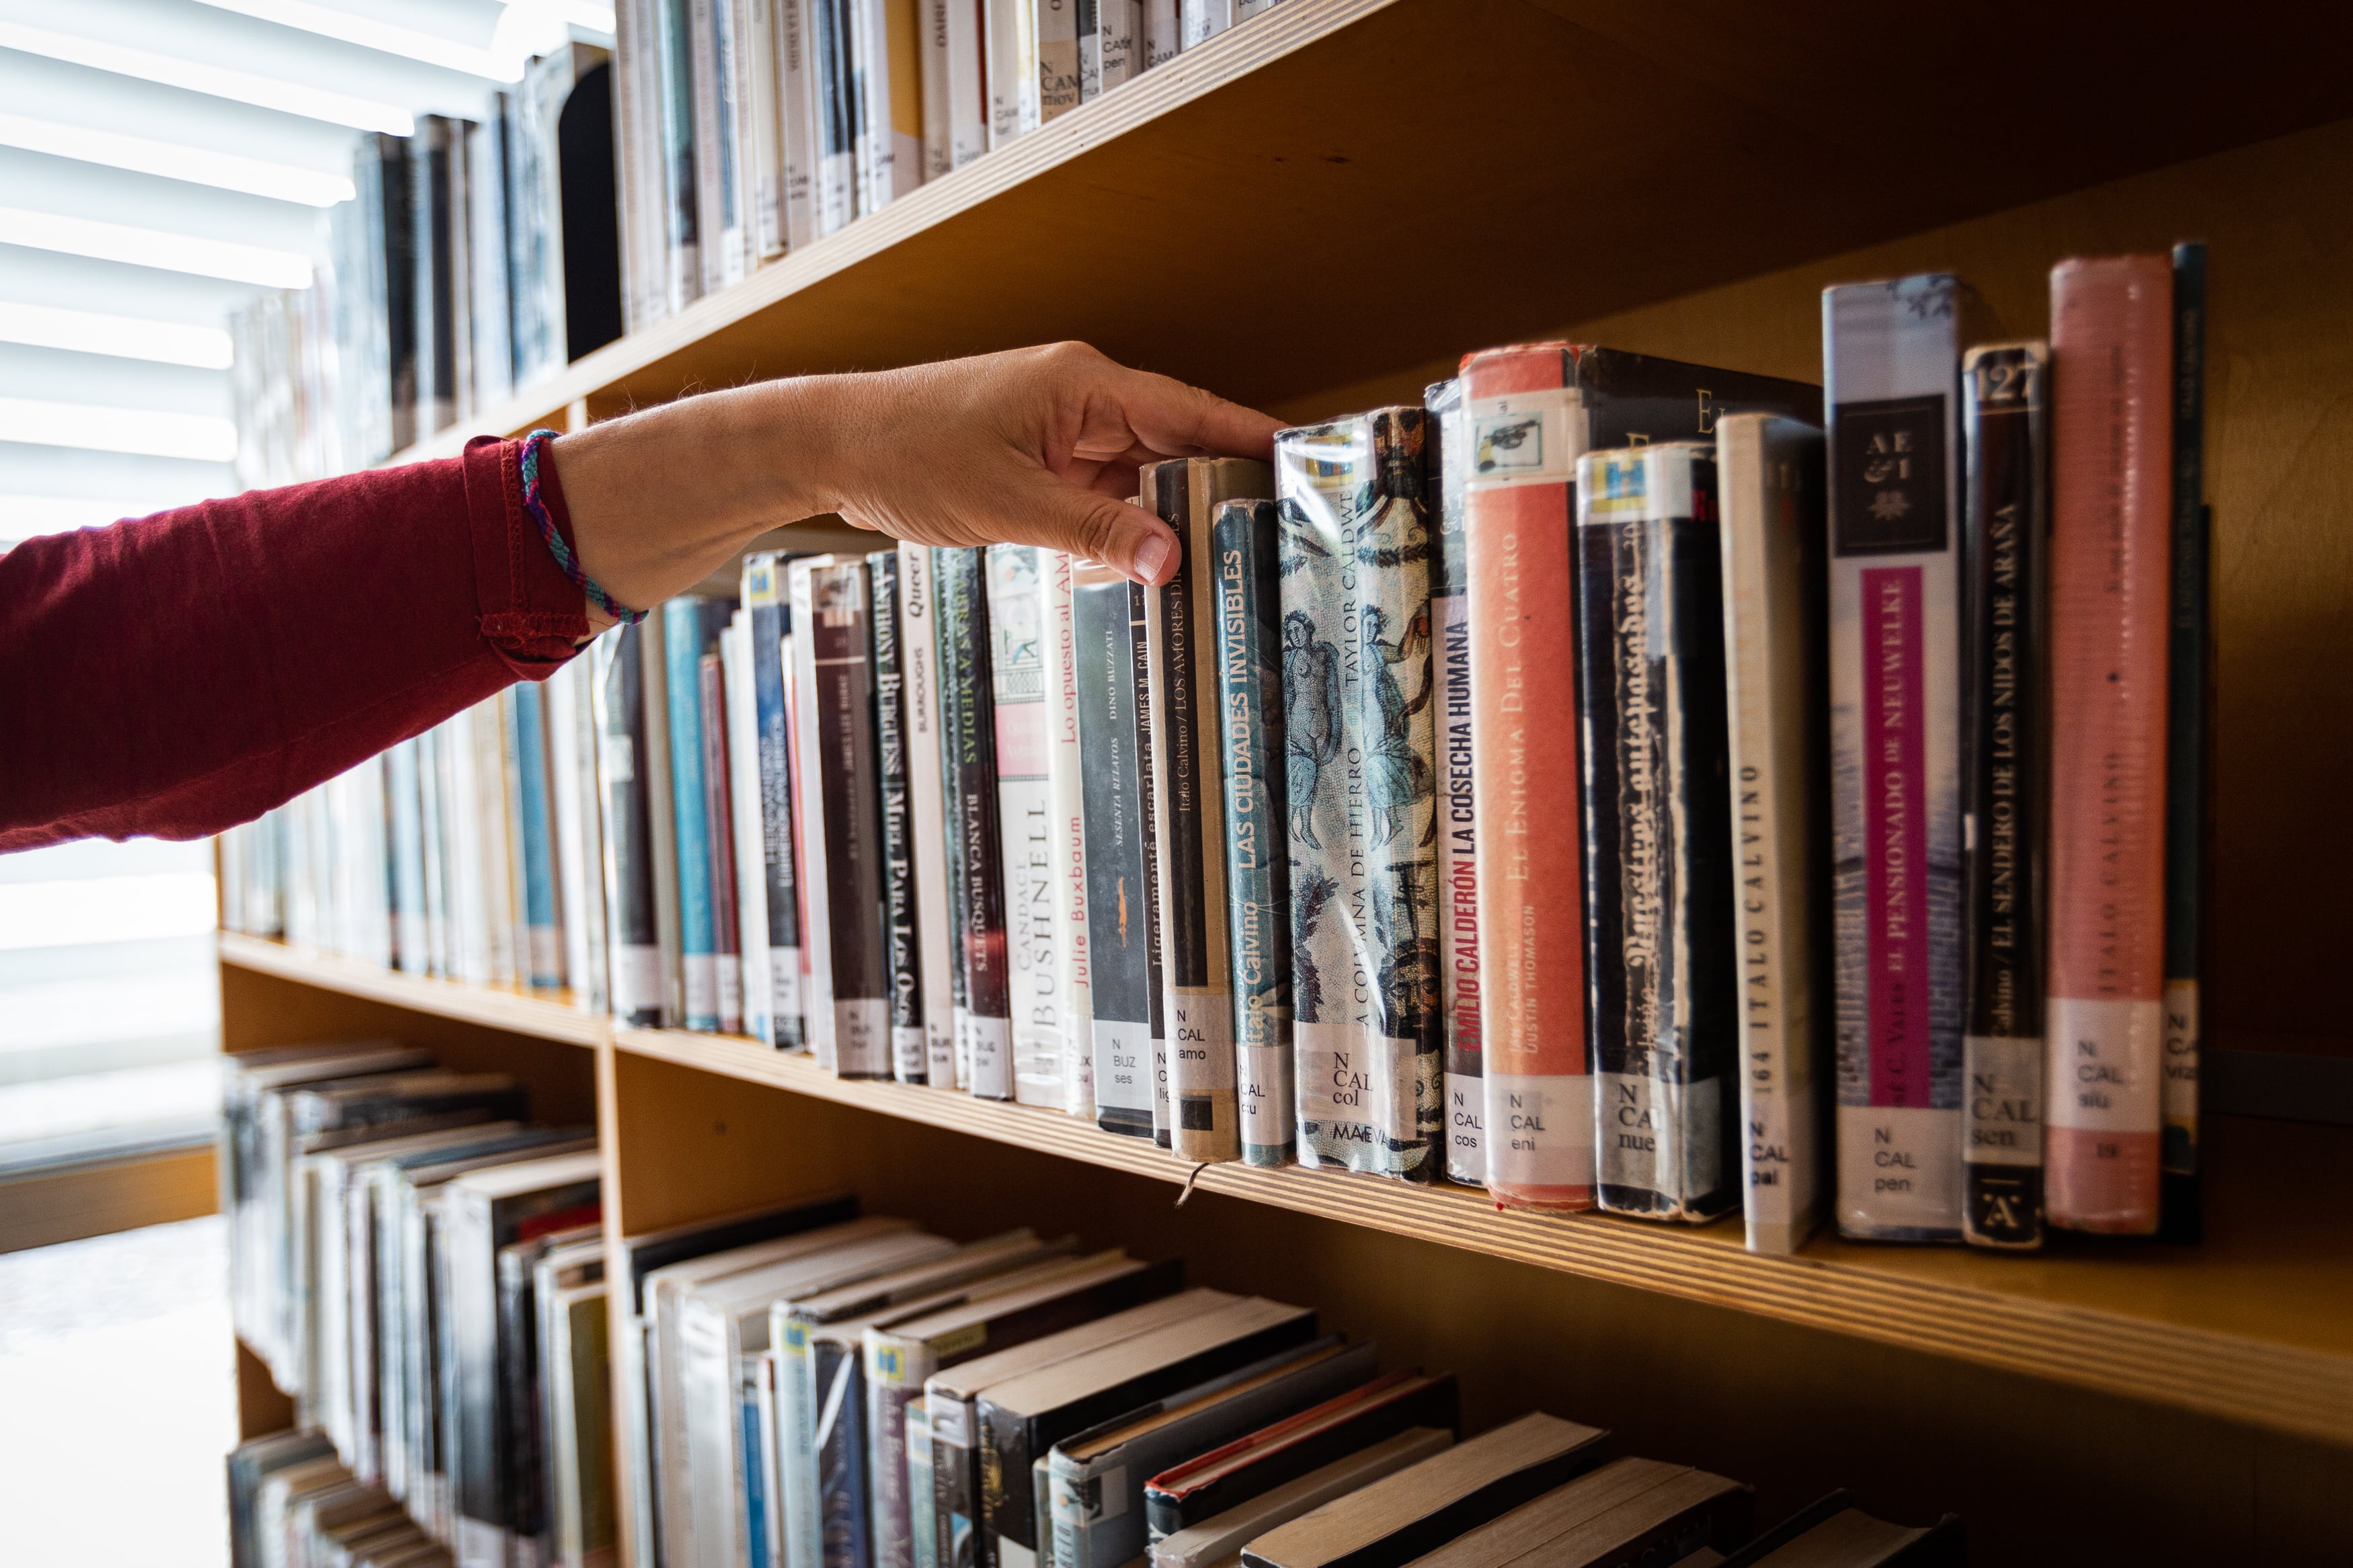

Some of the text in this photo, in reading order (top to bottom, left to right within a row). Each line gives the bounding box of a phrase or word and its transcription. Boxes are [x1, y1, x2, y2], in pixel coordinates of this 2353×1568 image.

[1340, 491, 1356, 590] CALDWE
[1055, 604, 1070, 621] al
[1171, 601, 1185, 673] AMORES
[1344, 599, 1359, 688] TAYLOR
[1106, 630, 1115, 683] BUZZATI
[1060, 629, 1076, 710] opuesto
[1109, 686, 1117, 720] DINO
[1174, 679, 1187, 710] LOS
[959, 677, 978, 764] MEDIAS
[1061, 718, 1076, 744] Lo
[1176, 725, 1189, 778] Calvino
[1179, 782, 1191, 812] Italo
[1223, 550, 1265, 1041] talo Calvino LAS CIUDADES INVISIBLES
[1348, 747, 1364, 838] HIERRO
[967, 794, 984, 872] BLANCA
[1446, 621, 1481, 1052] EMILIO CALDERÓN LA COSECHA HUMANA
[1351, 849, 1365, 877] DE
[1027, 800, 1056, 1026] BUSHNELL
[1068, 817, 1089, 989] Julie Buxbaum
[1177, 1009, 1186, 1022] N
[1112, 1038, 1121, 1050] N
[1178, 1028, 1205, 1042] CAL
[1113, 1055, 1137, 1068] BUZ
[1179, 1049, 1206, 1060] amo
[1333, 1052, 1349, 1070] N
[1114, 1074, 1133, 1084] ses
[1333, 1069, 1374, 1091] CAL
[1332, 1089, 1359, 1106] col
[1454, 1091, 1464, 1107] N
[1510, 1094, 1522, 1108] N
[1618, 1083, 1637, 1104] N
[1454, 1112, 1482, 1130] CAL
[1510, 1114, 1546, 1131] CAL
[1618, 1106, 1654, 1130] CA
[1455, 1134, 1478, 1148] cos
[1511, 1137, 1536, 1151] eni
[1618, 1133, 1655, 1152] nue
[1874, 1128, 1890, 1144] N
[1874, 1151, 1916, 1169] CAL
[1874, 1178, 1911, 1193] pen
